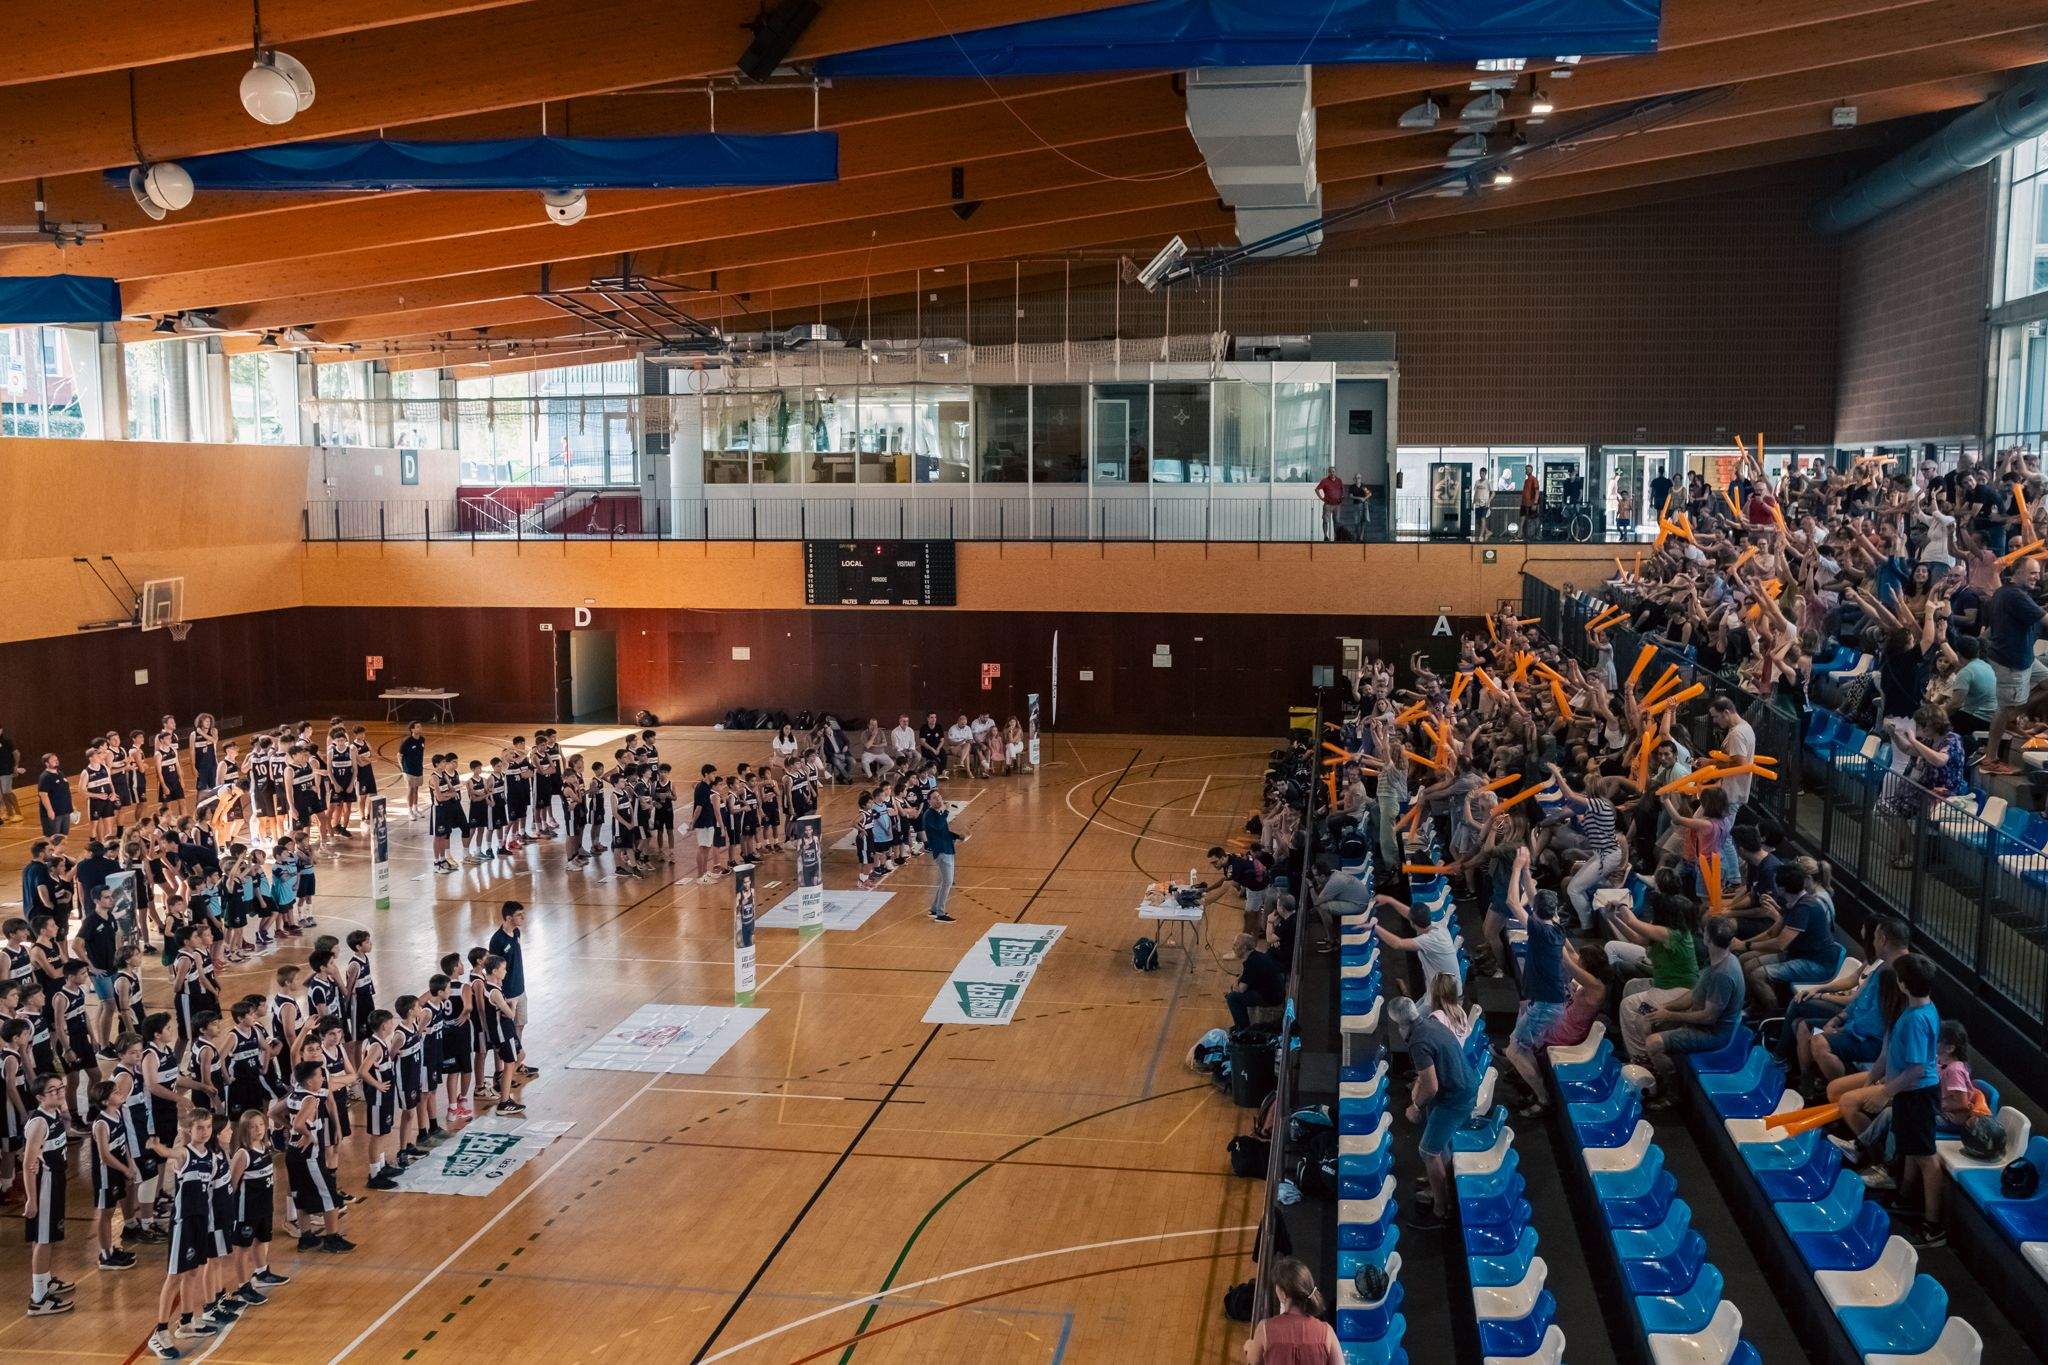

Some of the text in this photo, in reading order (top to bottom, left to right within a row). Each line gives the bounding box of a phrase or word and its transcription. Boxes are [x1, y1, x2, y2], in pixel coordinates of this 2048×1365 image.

[405, 456, 415, 478] D
[575, 607, 591, 626] D
[1432, 615, 1452, 636] A
[255, 764, 267, 775] 10
